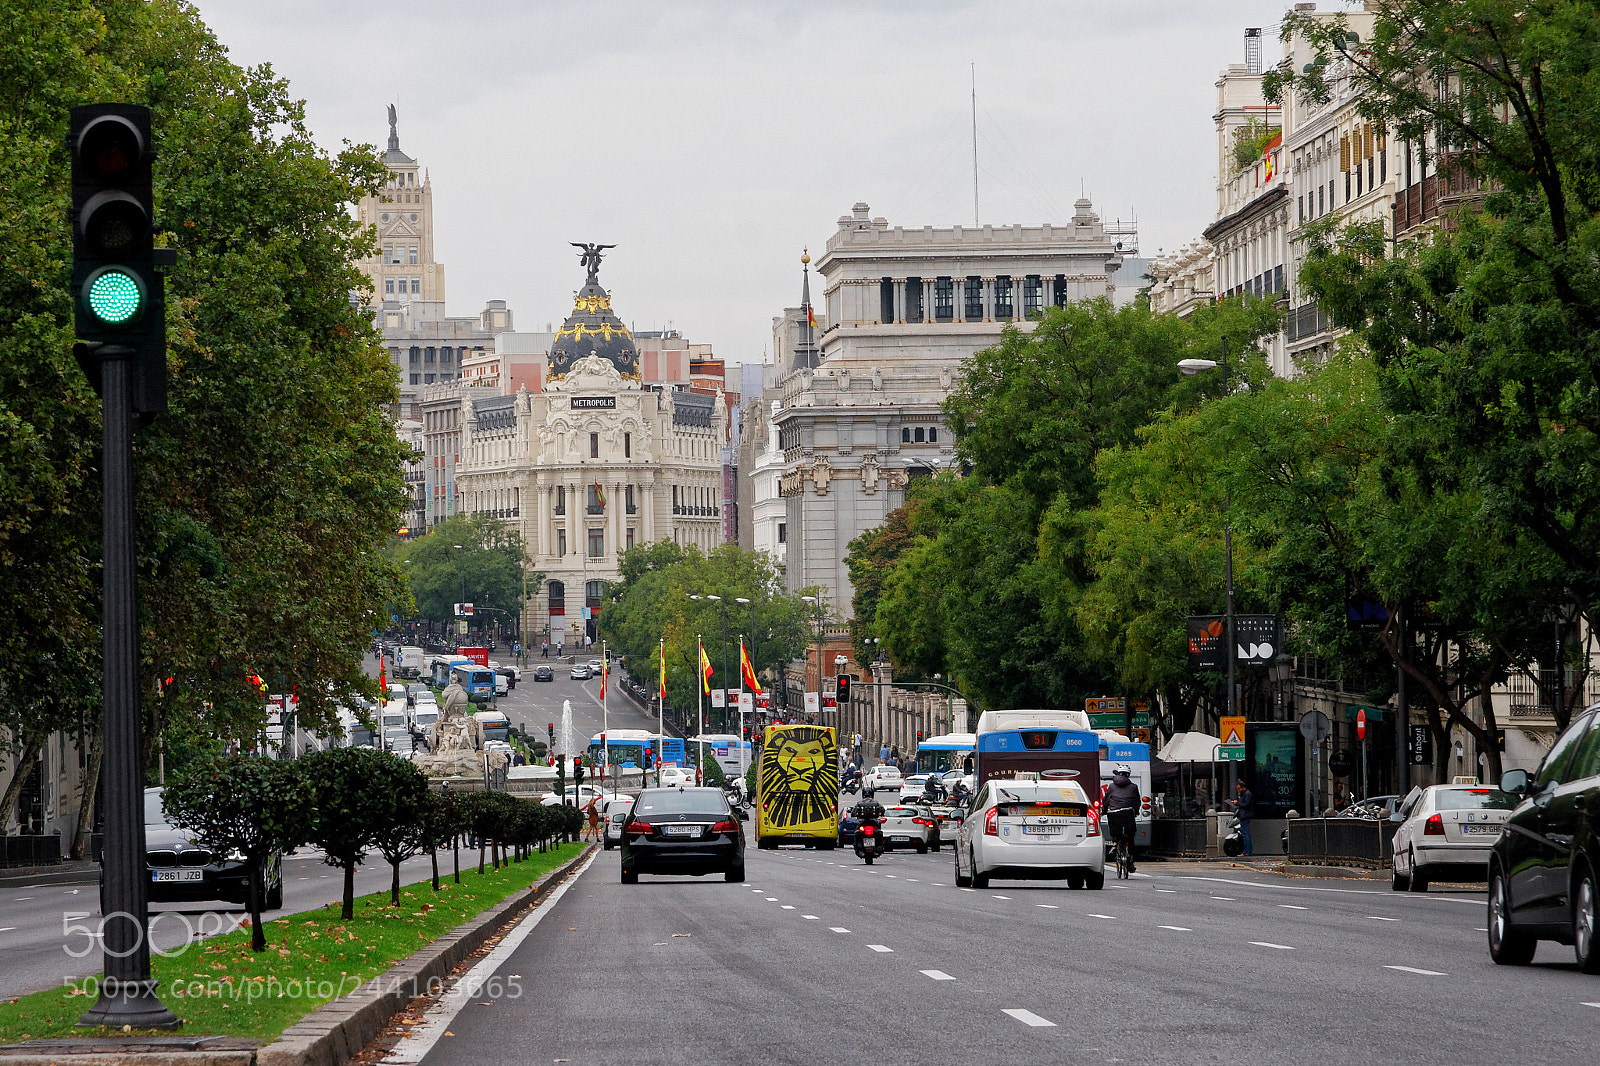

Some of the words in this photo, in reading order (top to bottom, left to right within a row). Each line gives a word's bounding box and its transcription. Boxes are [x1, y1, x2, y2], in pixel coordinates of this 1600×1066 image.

[573, 399, 614, 407] METROPOLIS
[1034, 734, 1046, 745] 51
[1278, 786, 1289, 794] 30
[159, 872, 180, 880] 2861
[185, 871, 201, 880] JZB
